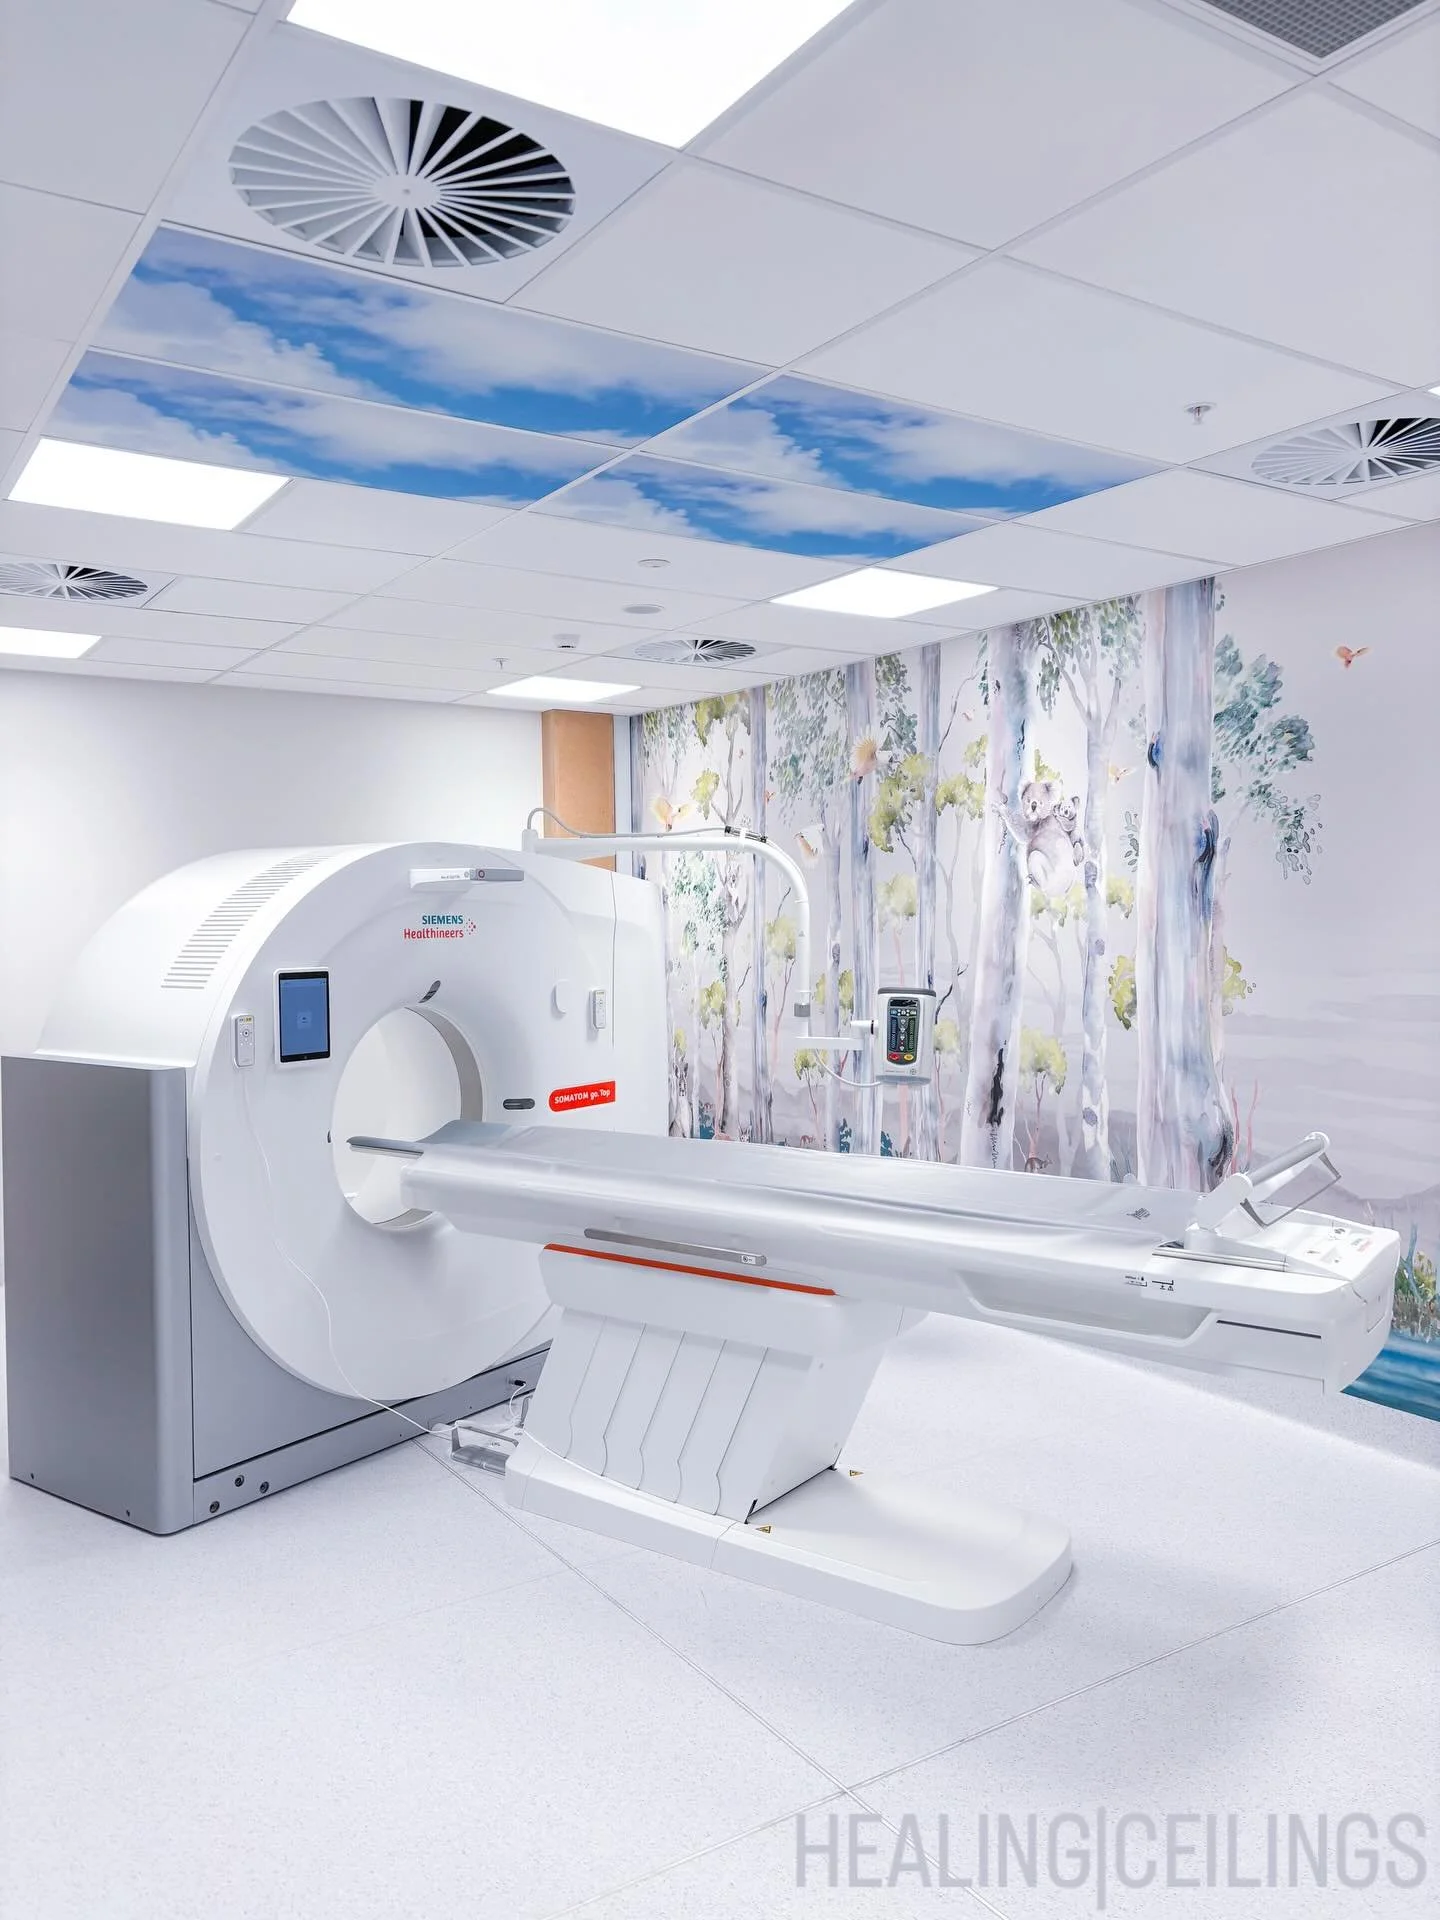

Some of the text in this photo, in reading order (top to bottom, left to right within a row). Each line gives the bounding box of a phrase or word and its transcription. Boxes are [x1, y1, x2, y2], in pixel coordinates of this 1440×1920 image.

[422, 915, 464, 925] SIEMENS
[404, 927, 464, 939] Healthineers
[554, 1092, 589, 1104] SOMATOM
